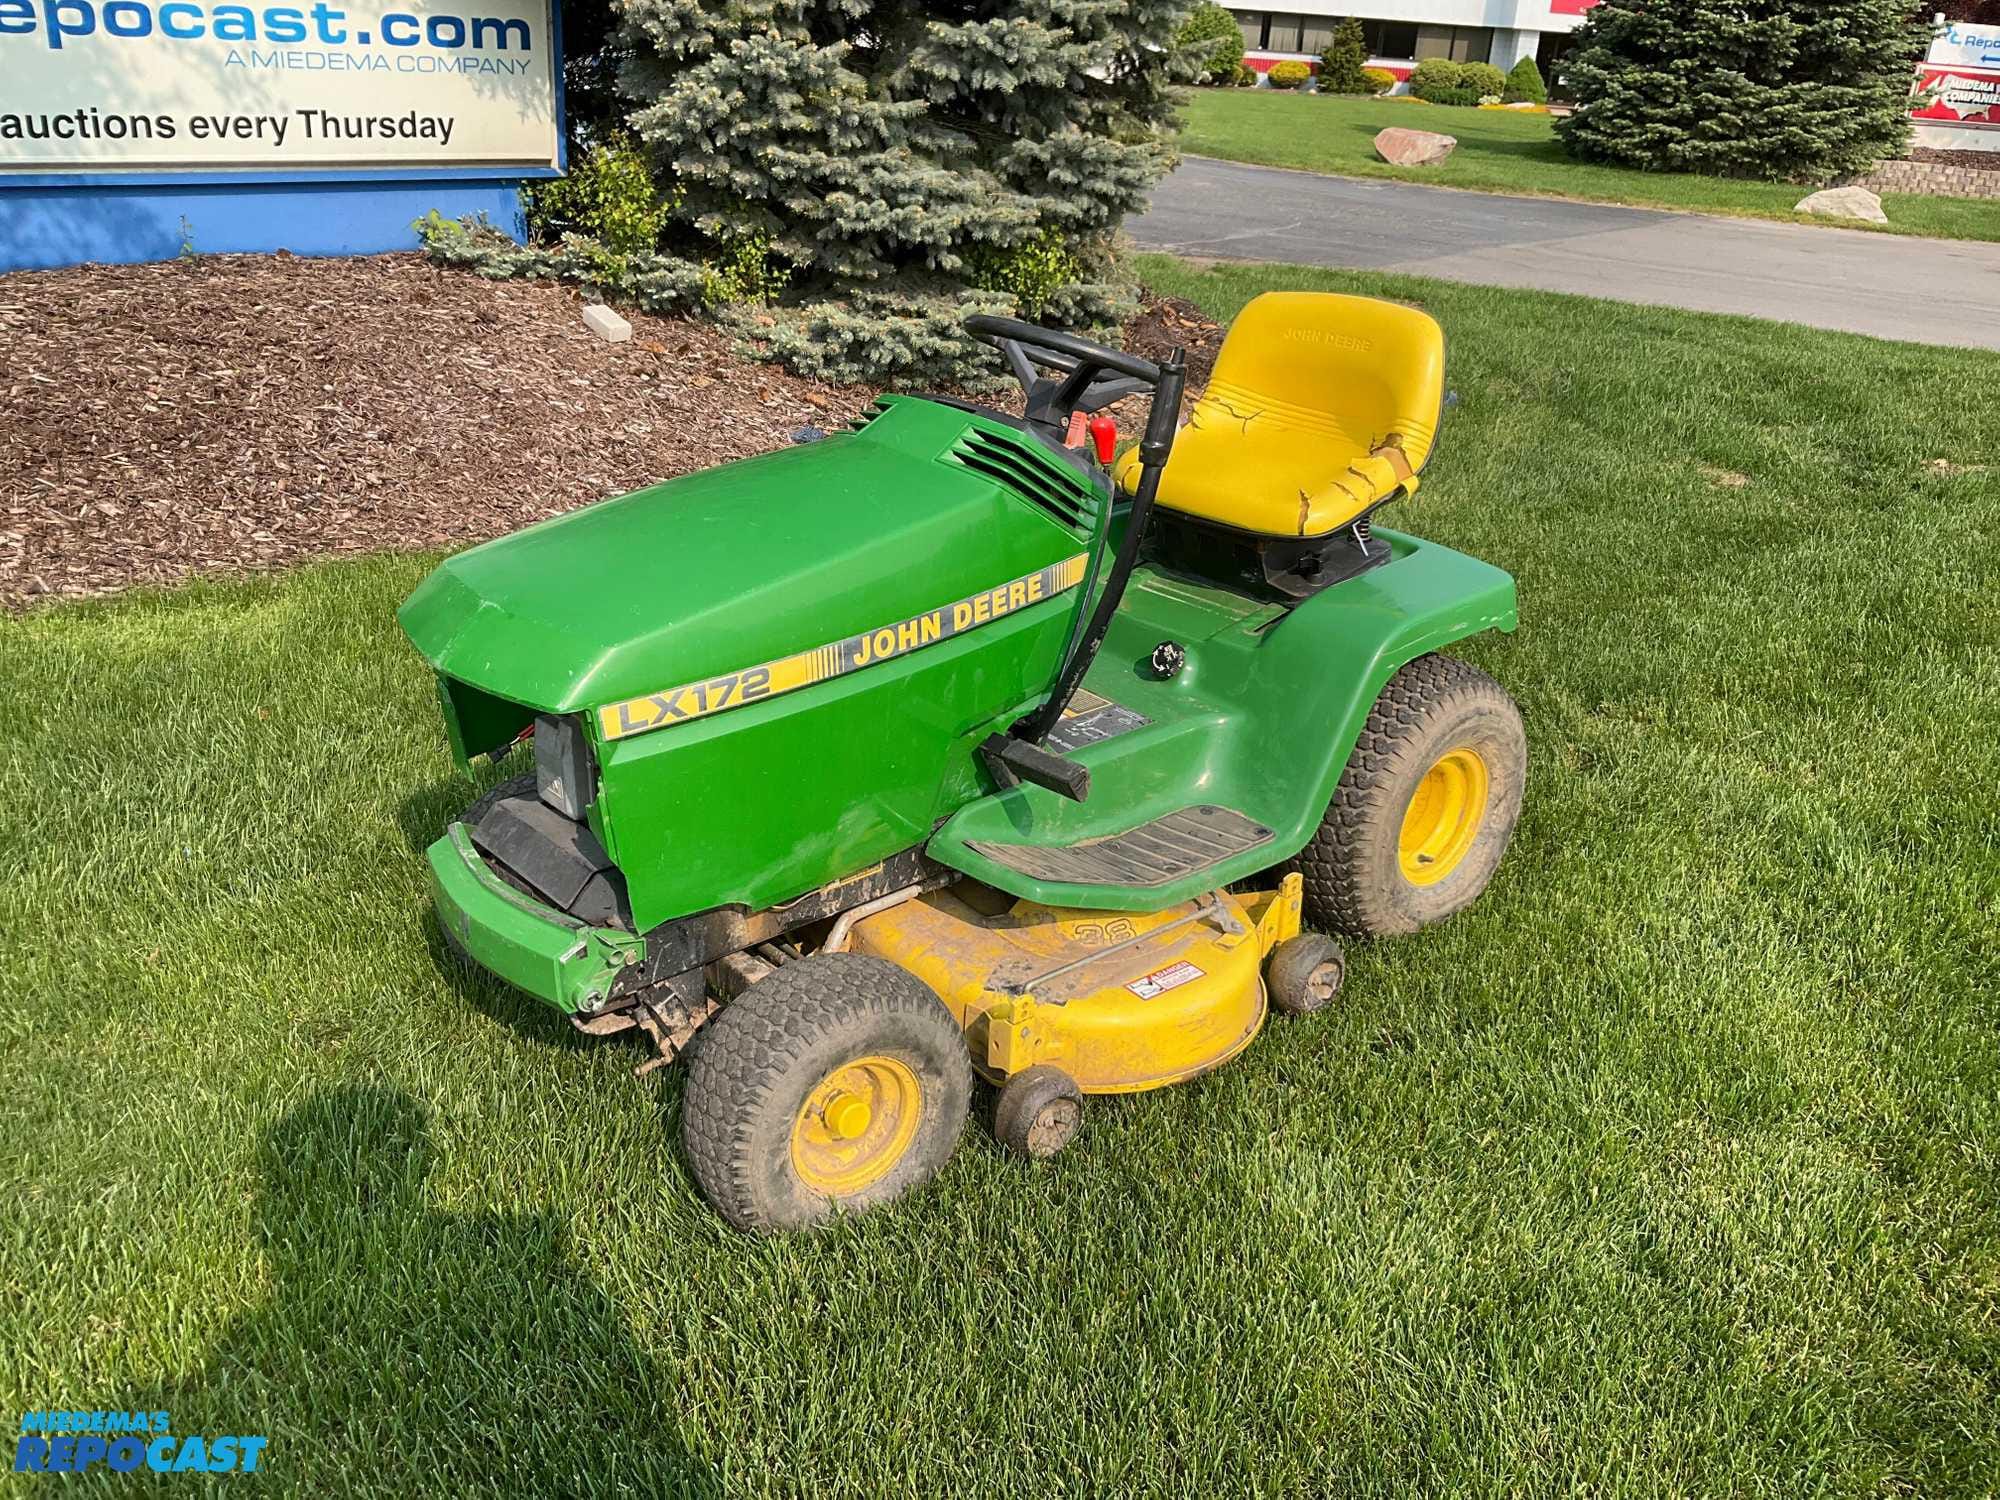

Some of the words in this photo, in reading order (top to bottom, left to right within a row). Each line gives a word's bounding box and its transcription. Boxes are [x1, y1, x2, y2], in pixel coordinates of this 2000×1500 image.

[225, 50, 247, 68] A
[251, 51, 391, 73] MIEDEMA
[397, 55, 531, 76] COMPANY
[0, 108, 176, 139] auctions
[188, 117, 288, 146] every
[296, 109, 454, 145] Thursday
[1282, 327, 1321, 344] JOHN
[1325, 331, 1374, 352] DEERE
[618, 667, 771, 733] LX172
[853, 611, 943, 667] JOHN
[953, 573, 1043, 632] DEERE
[1075, 918, 1136, 945] 38
